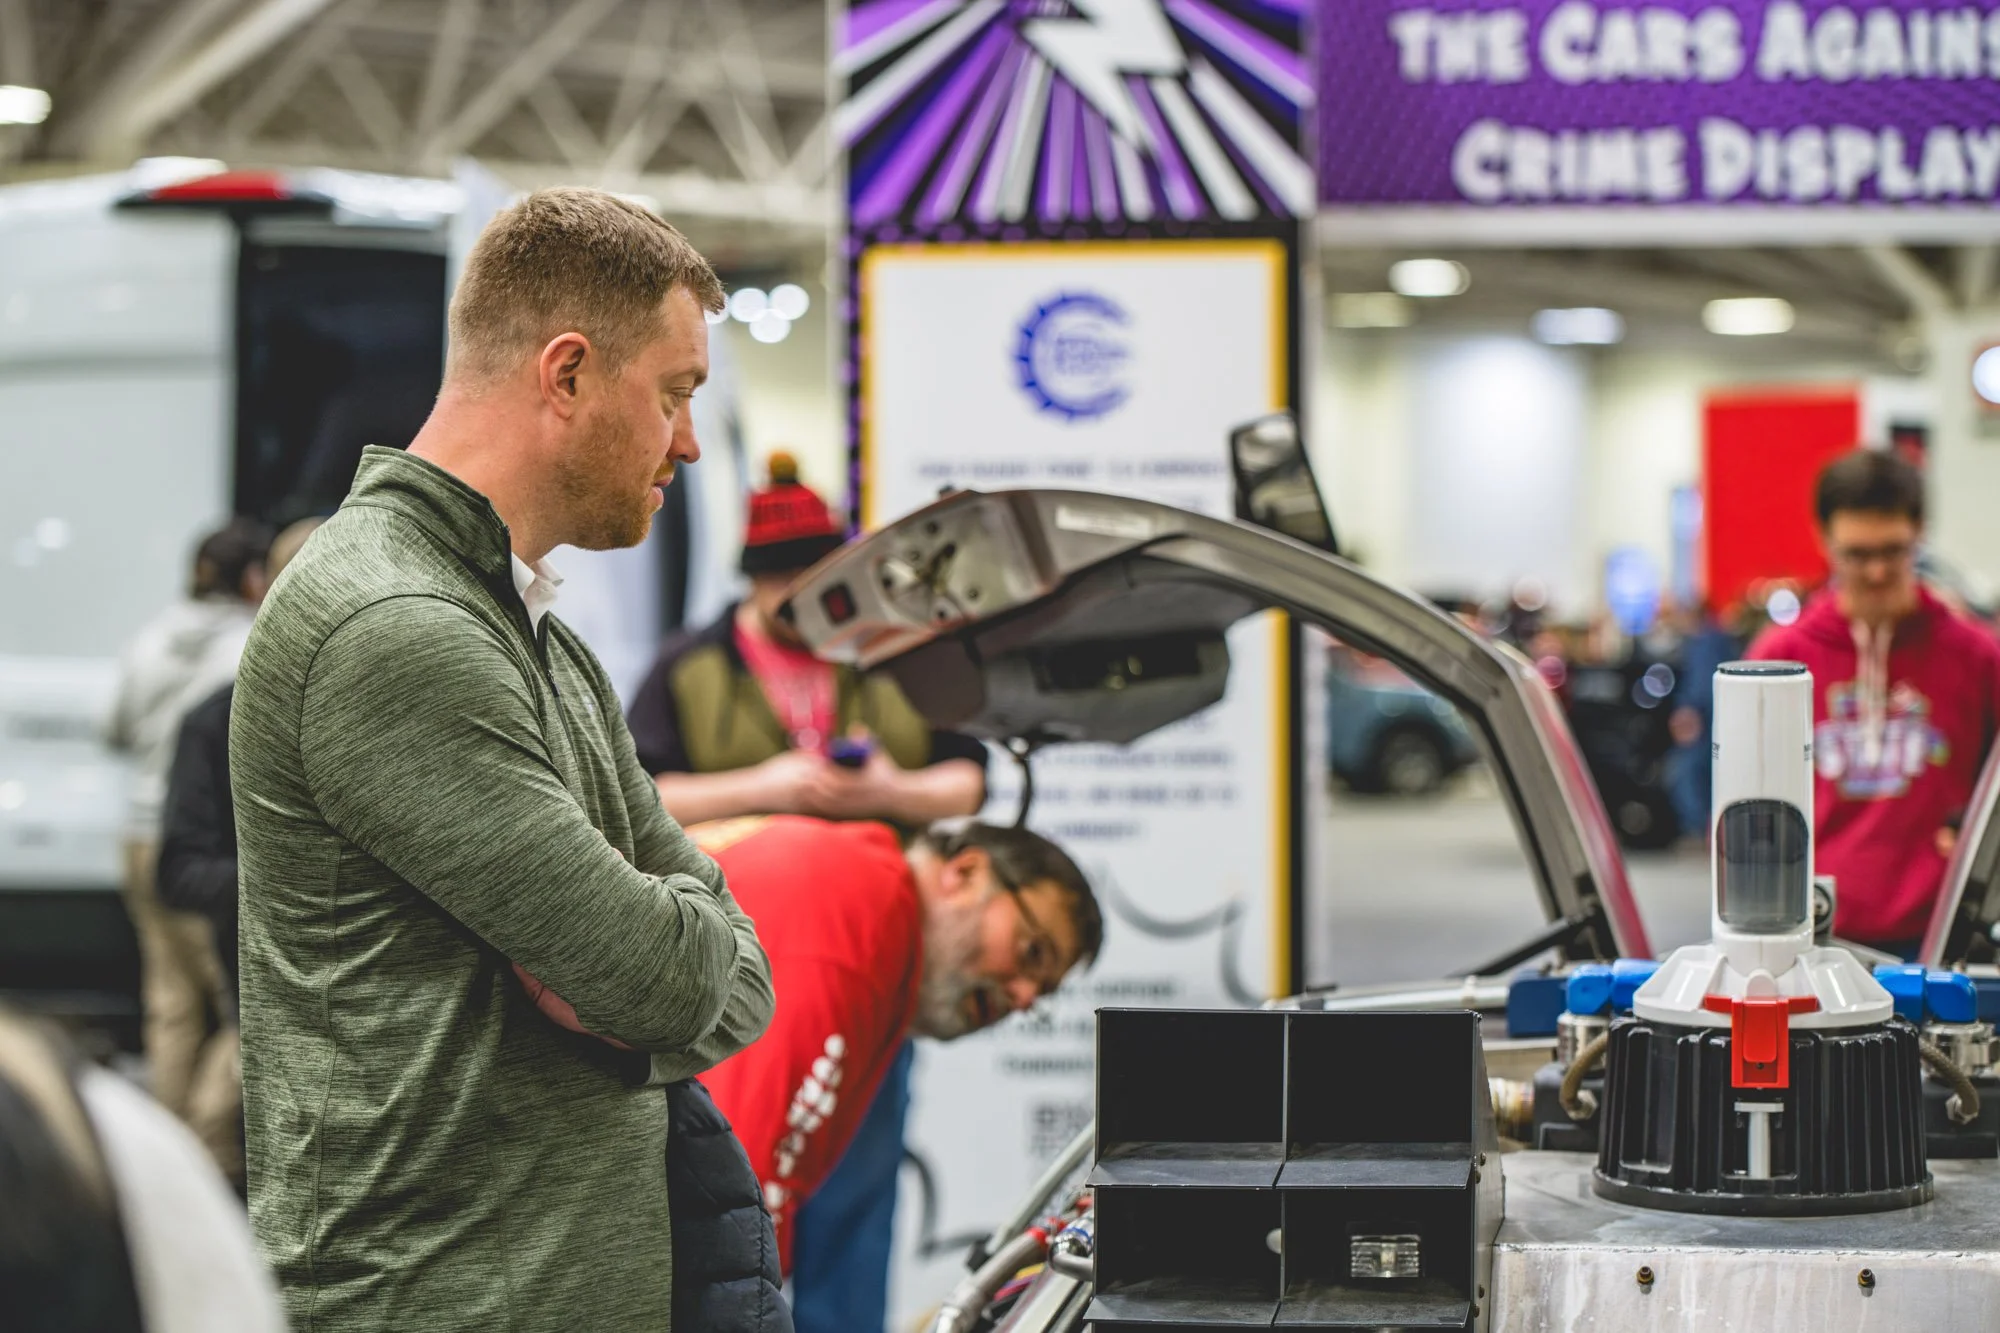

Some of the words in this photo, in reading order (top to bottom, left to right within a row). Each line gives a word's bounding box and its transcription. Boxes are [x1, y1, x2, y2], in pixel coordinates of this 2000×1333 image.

[1390, 11, 1530, 82] THE
[1539, 1, 1744, 83] CARS
[1757, 0, 2000, 82] AGAIN
[1451, 119, 1688, 202] CRIME
[1699, 116, 2000, 200] DISPLAY
